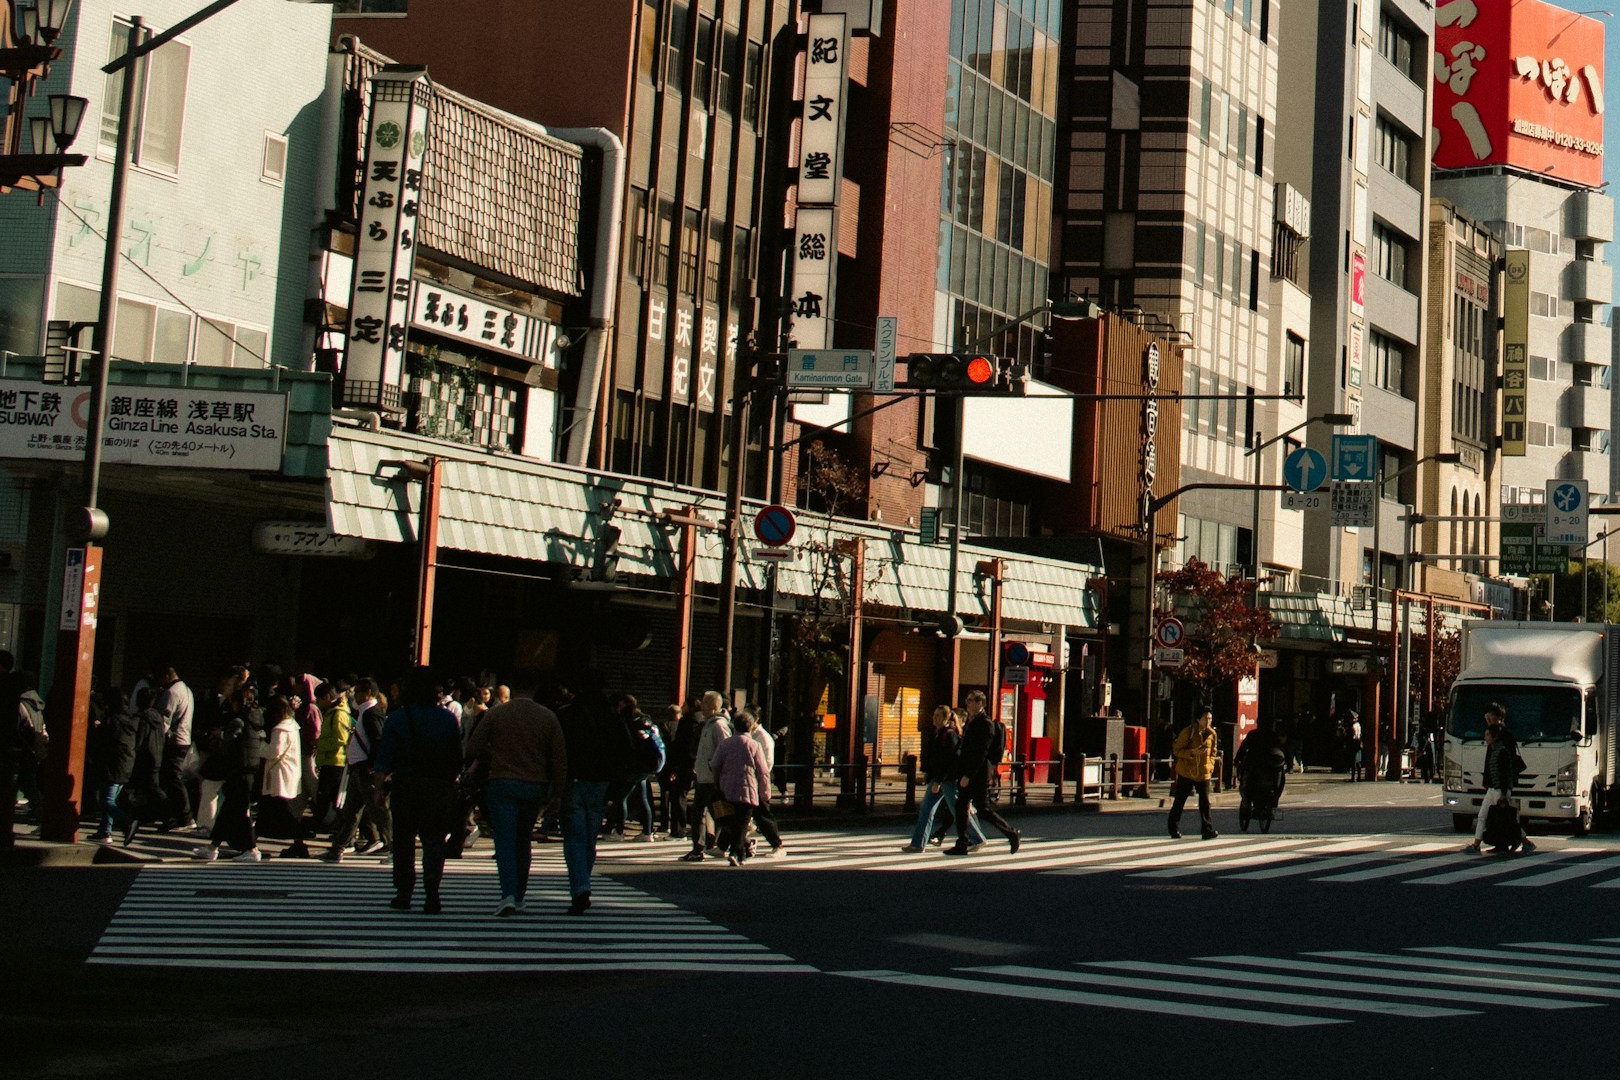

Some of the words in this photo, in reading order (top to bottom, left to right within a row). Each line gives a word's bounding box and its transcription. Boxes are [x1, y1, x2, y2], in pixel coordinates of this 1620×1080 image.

[1515, 55, 1605, 116] つぼ八
[802, 354, 859, 371] 雷門
[877, 318, 893, 390] スクランブル式
[794, 373, 842, 383] Kaminarimon
[845, 374, 863, 383] Gate
[0, 390, 62, 414] 地下鉄
[1504, 345, 1525, 441] 神谷バー
[110, 395, 179, 420] 銀座線
[188, 399, 256, 423] 浅草駅
[109, 417, 148, 432] Ginza
[150, 419, 179, 434] Line
[185, 421, 247, 438] Asakusa
[249, 425, 278, 439] Sta.
